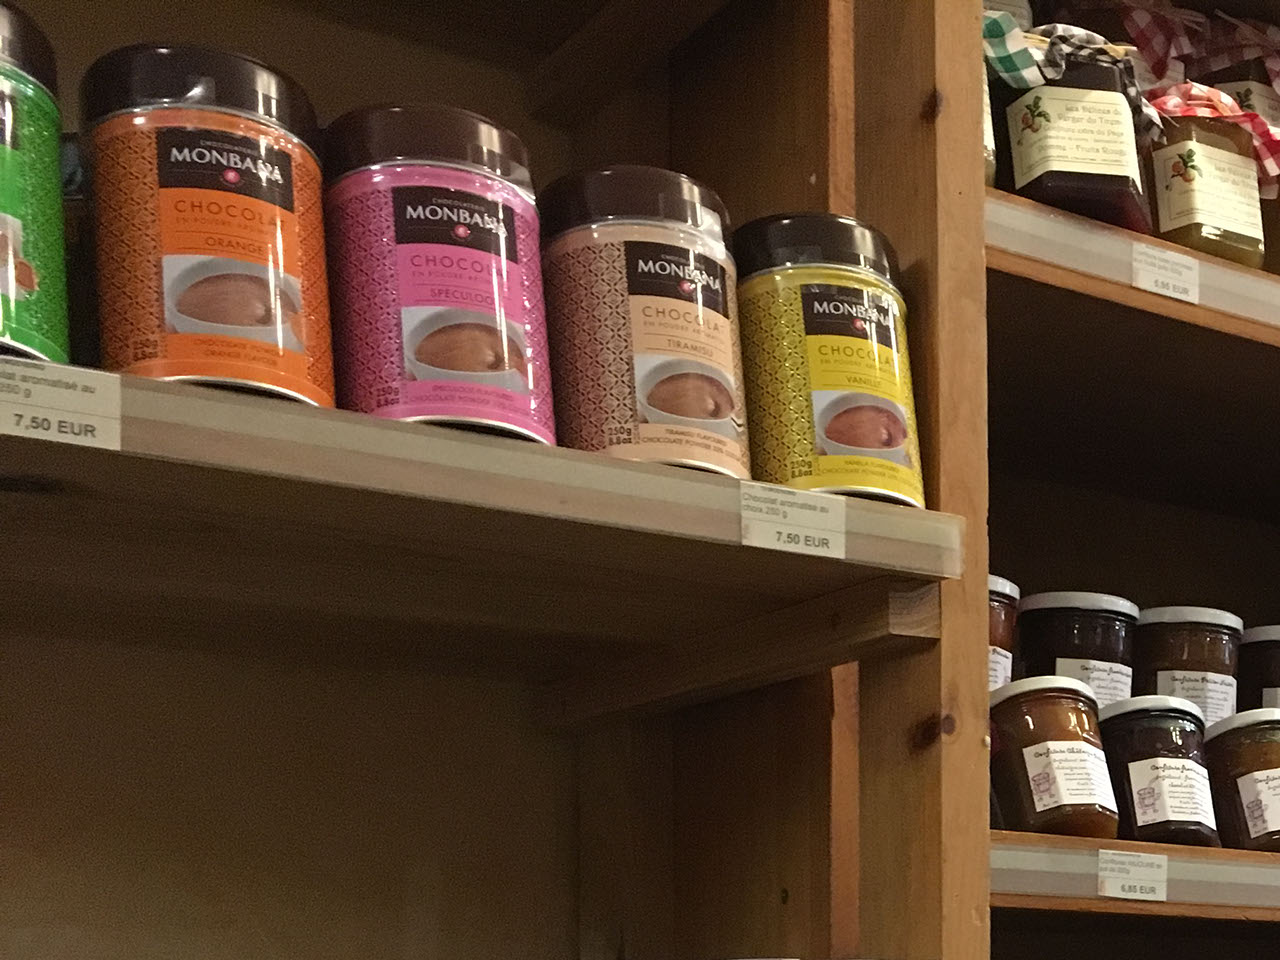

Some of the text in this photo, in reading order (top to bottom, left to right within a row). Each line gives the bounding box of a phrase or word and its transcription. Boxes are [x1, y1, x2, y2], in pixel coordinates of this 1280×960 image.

[13, 413, 97, 438] 7,50 EUR
[608, 427, 632, 438] 250g
[776, 531, 830, 549] 7,50 EUR
[1139, 885, 1156, 895] EUR
